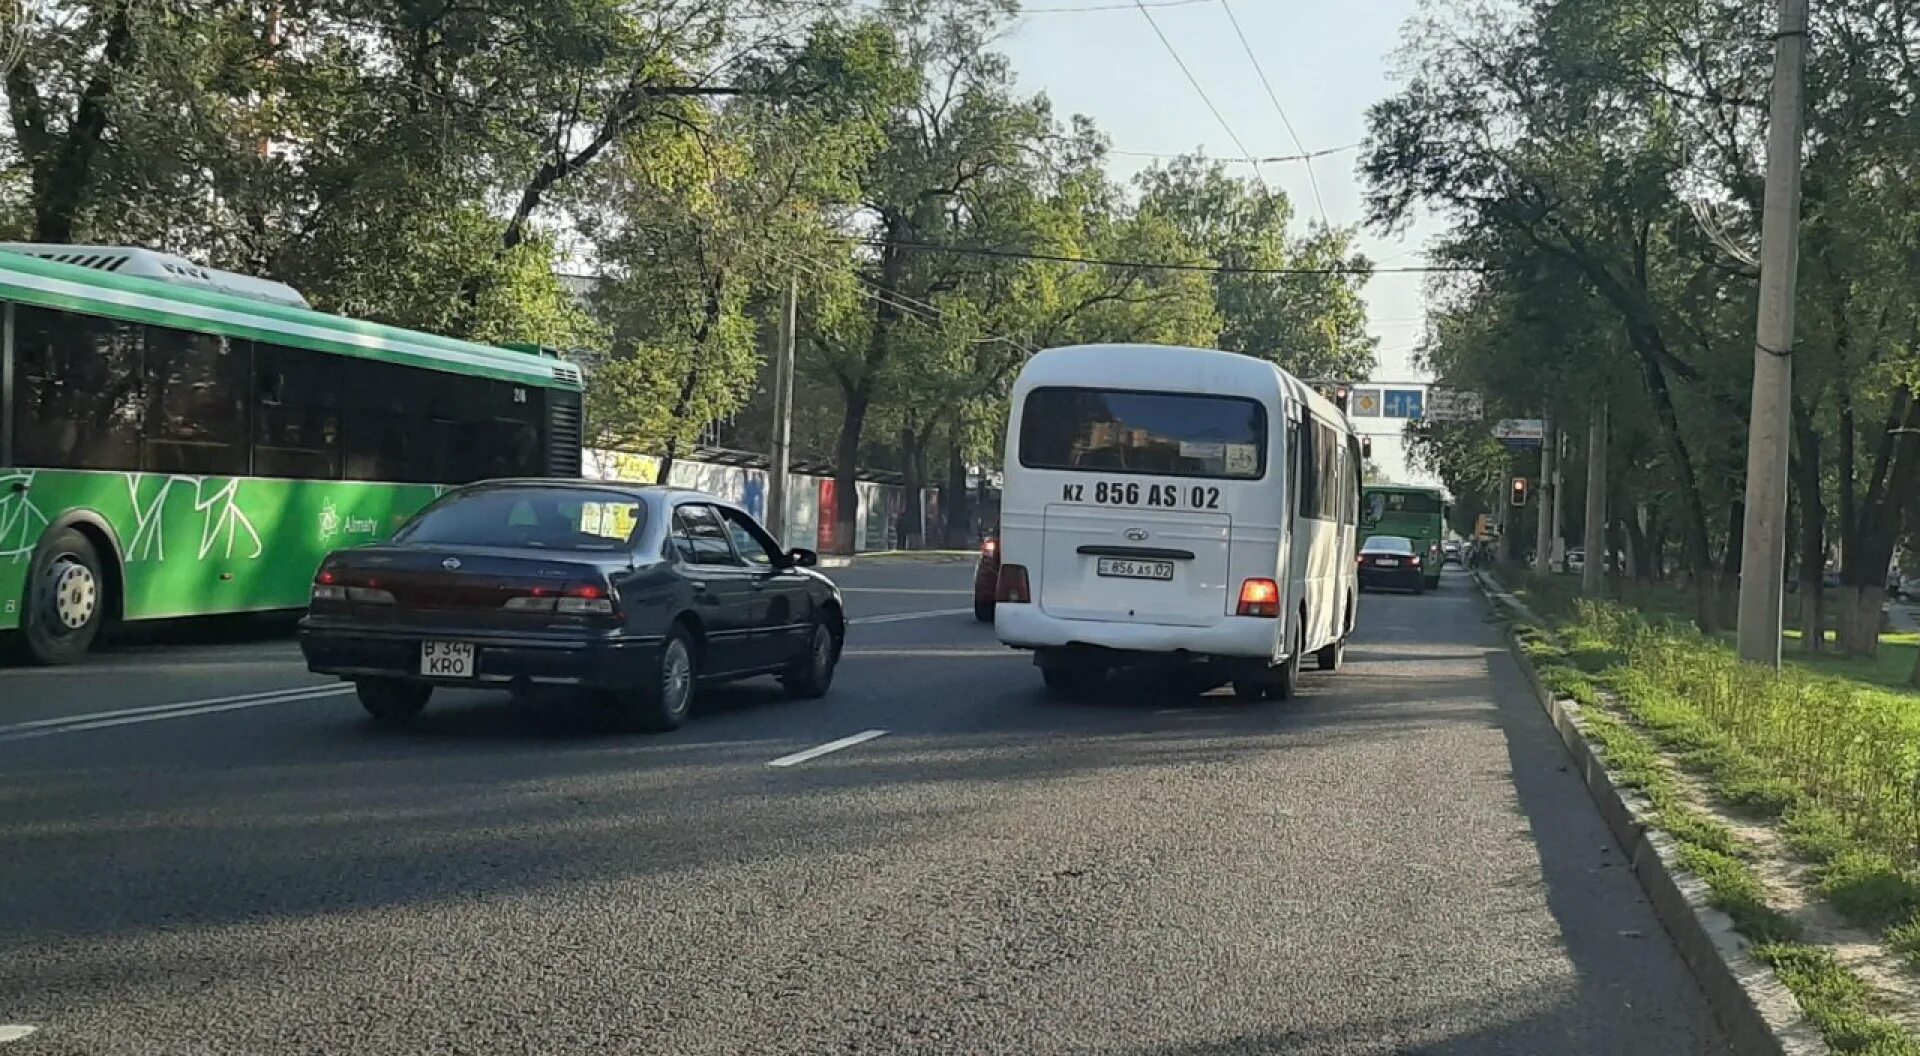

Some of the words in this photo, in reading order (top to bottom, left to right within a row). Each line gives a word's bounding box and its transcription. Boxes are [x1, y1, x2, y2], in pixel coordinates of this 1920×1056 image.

[1063, 483, 1084, 501] KZ
[1095, 481, 1140, 505] 856
[1147, 484, 1177, 507] AS
[1191, 486, 1220, 509] 02
[343, 514, 378, 536] Almaty
[1111, 561, 1134, 574] 856
[1137, 564, 1152, 575] AS
[1156, 563, 1171, 577] 02
[442, 641, 472, 658] 344
[430, 657, 464, 674] KRO
